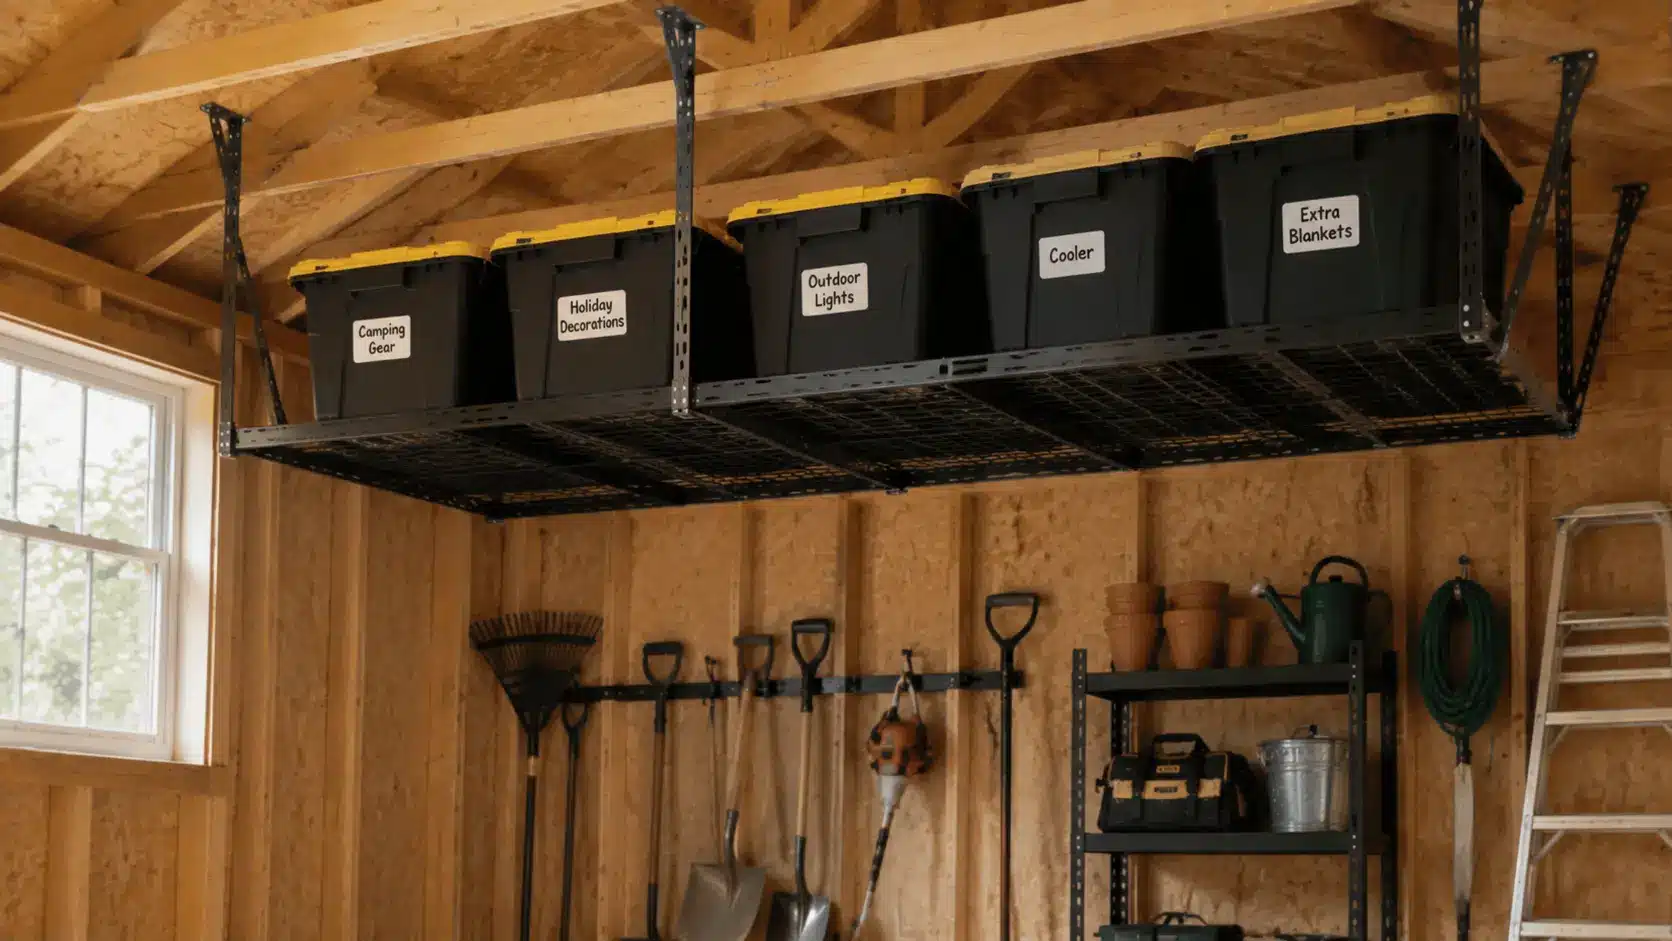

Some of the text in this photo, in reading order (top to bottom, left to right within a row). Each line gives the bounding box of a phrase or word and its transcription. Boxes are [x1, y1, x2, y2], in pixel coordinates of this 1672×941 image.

[1300, 205, 1341, 223] Extra
[1288, 224, 1353, 245] Blankets
[1049, 244, 1095, 264] Cooler
[808, 270, 861, 289] Outdoor
[570, 297, 613, 315] Holiday
[815, 290, 855, 311] Lights
[358, 324, 406, 340] Camping
[560, 316, 625, 334] Decorations
[368, 341, 396, 355] Gear
